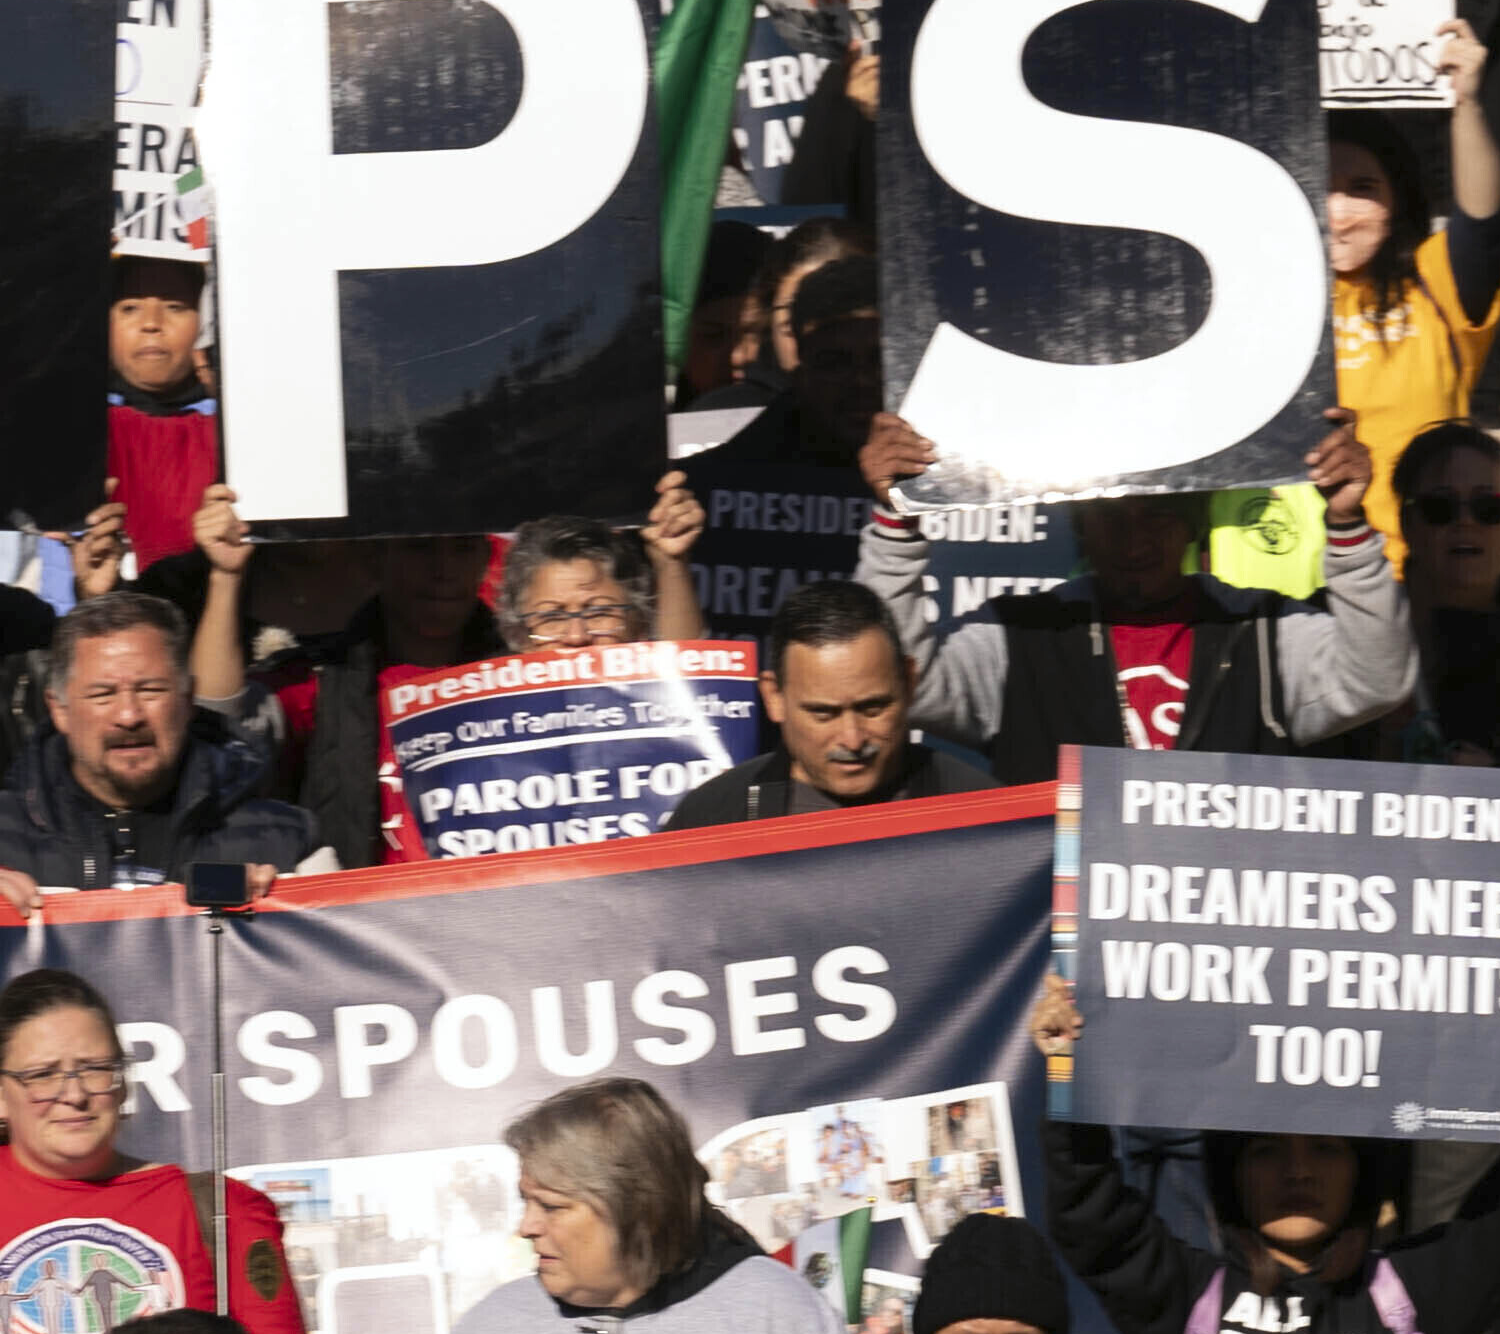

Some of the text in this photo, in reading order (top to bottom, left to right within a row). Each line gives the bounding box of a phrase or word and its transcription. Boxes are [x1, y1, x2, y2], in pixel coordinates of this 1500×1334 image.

[391, 641, 746, 717] President Biden:
[419, 761, 714, 822] PAROLE FOR
[1122, 779, 1364, 835] PRESIDENT
[1088, 862, 1396, 935] DREAMERS
[1101, 939, 1273, 1006] WORK
[237, 938, 894, 1107] SPOUSES
[1249, 1023, 1383, 1089] TOO!
